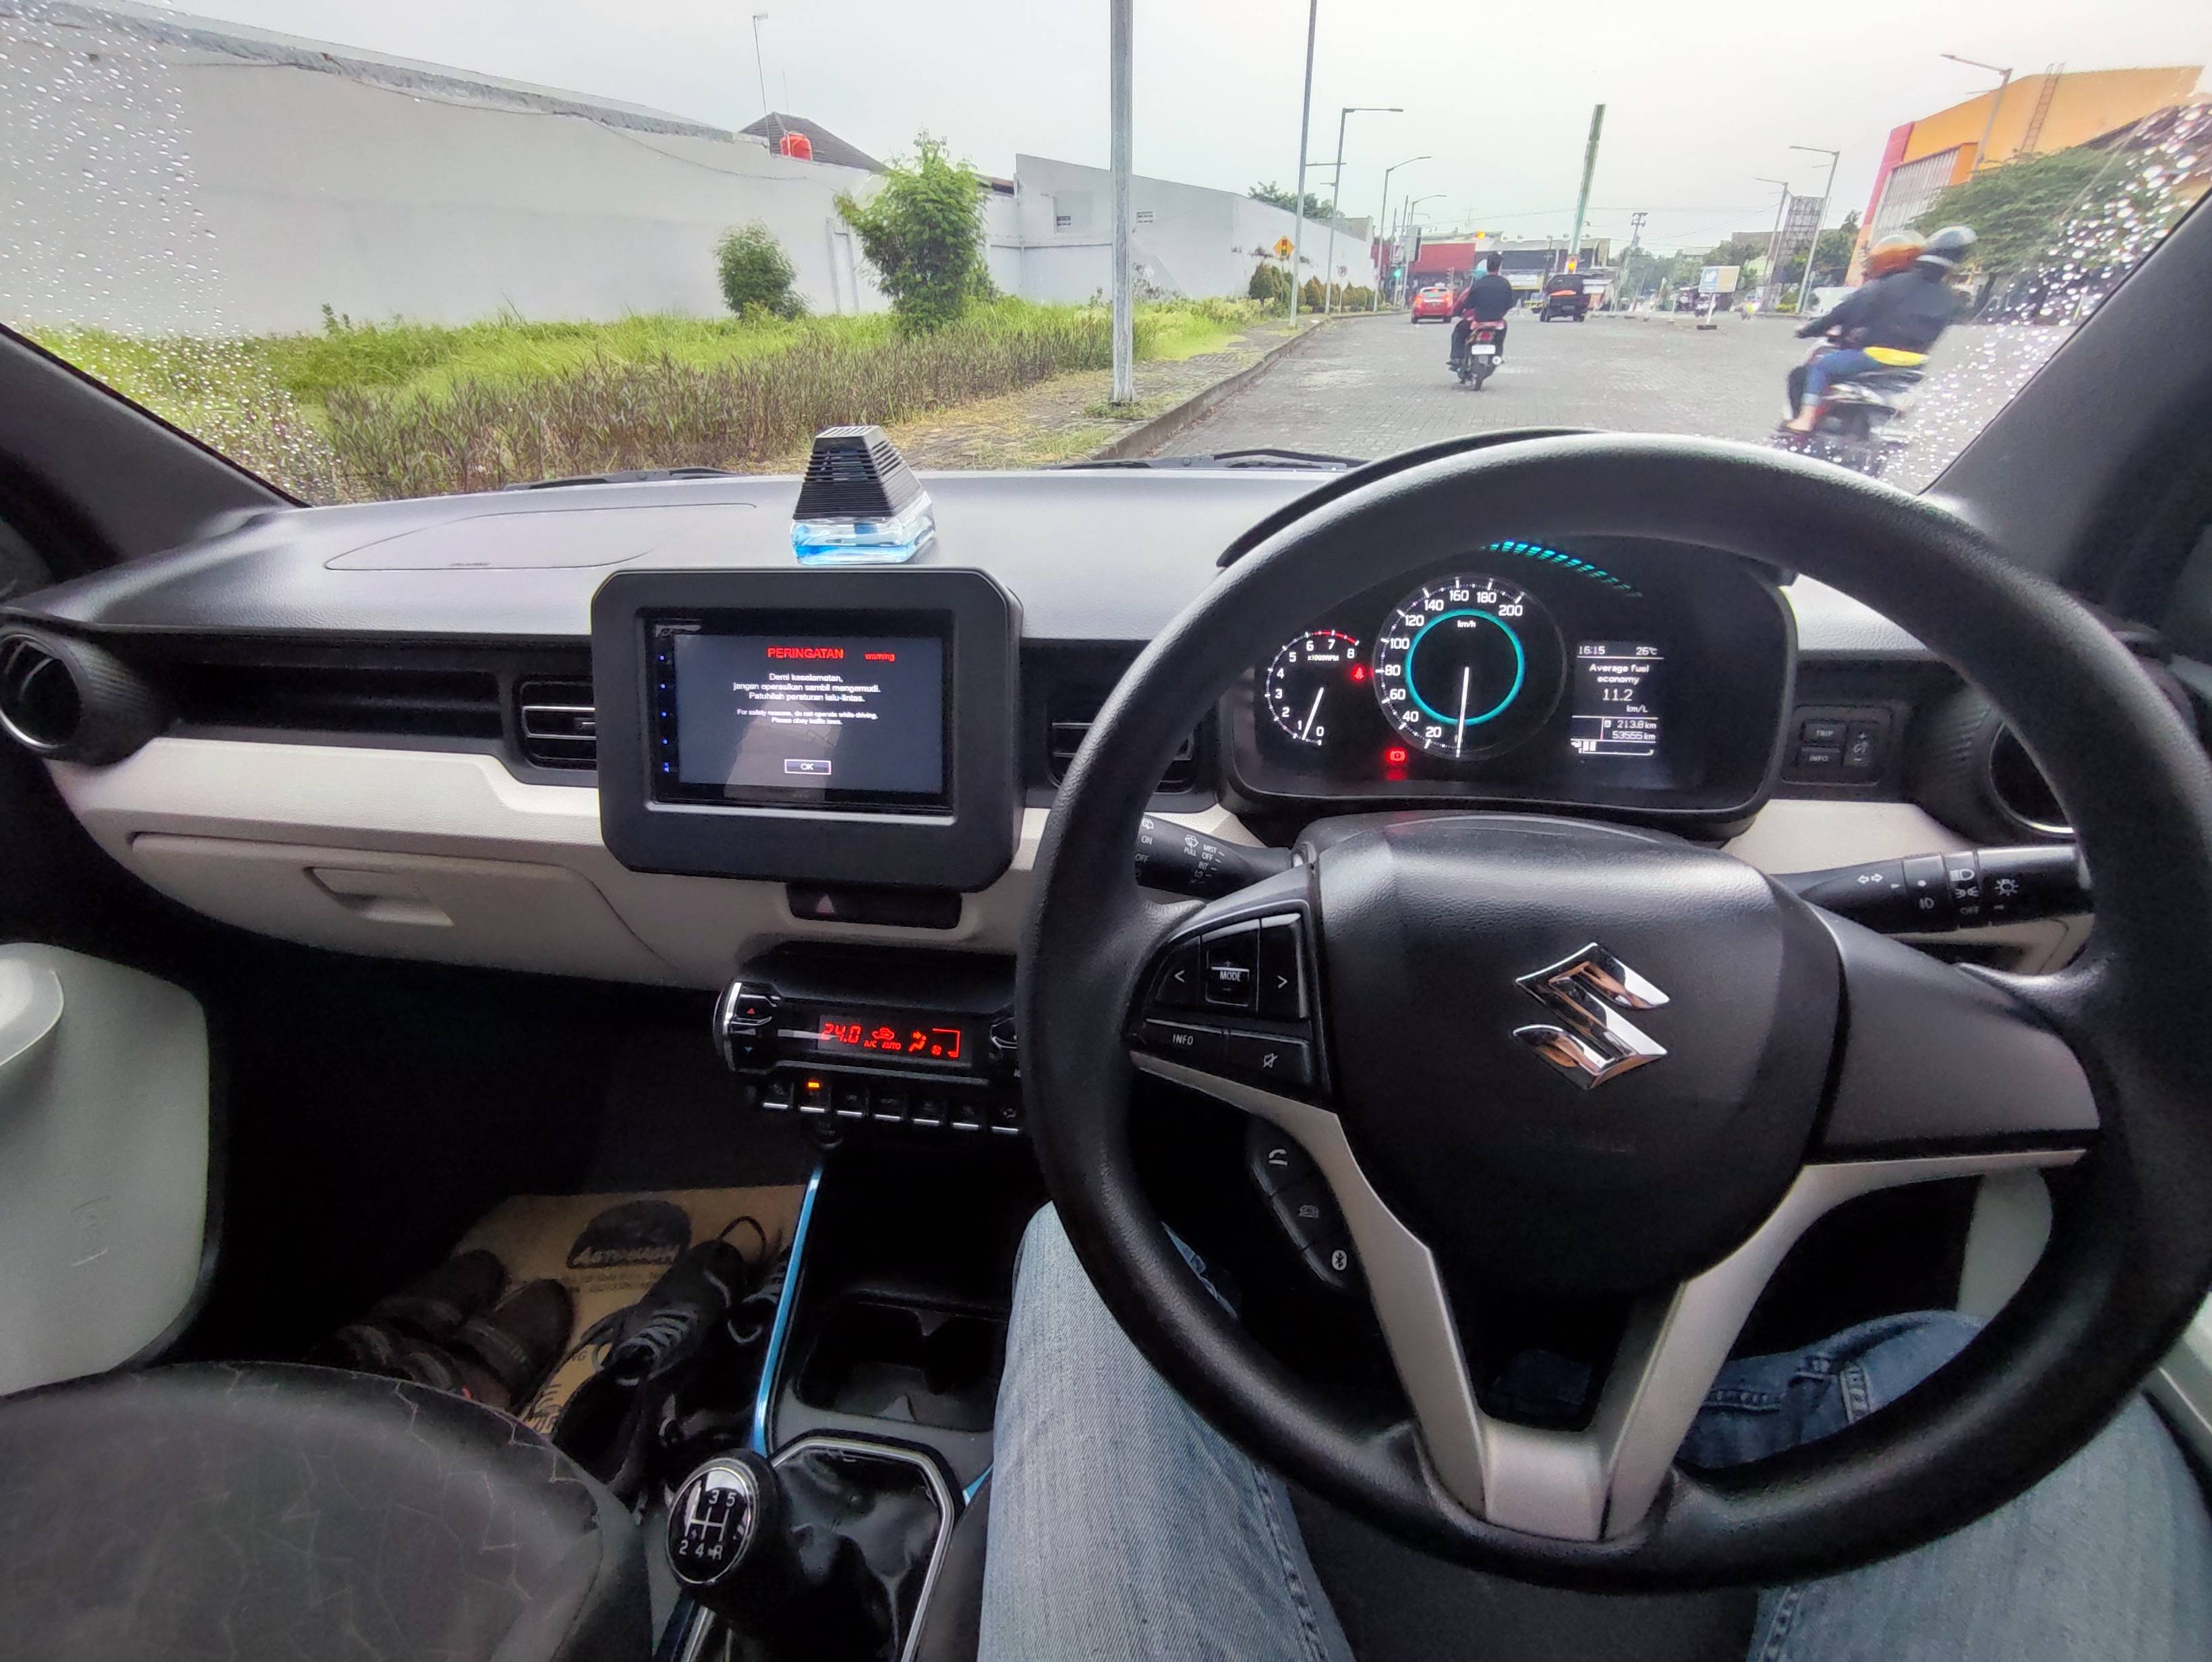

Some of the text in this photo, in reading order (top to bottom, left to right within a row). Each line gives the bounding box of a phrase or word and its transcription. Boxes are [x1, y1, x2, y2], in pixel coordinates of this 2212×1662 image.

[1450, 590, 1469, 602] 160
[1477, 592, 1496, 603] 180
[1424, 600, 1444, 611] 140
[1498, 604, 1523, 617] 200
[1405, 615, 1424, 626] 120
[1457, 620, 1476, 628] km/h
[1306, 641, 1314, 651] 6
[1328, 639, 1335, 650] 7
[1390, 638, 1409, 650] 100
[767, 648, 895, 661] PERINGATAN warning
[1347, 648, 1355, 659] 8
[1579, 646, 1606, 654] 16:15
[1289, 652, 1296, 662] 5
[1277, 668, 1284, 679] 4
[1385, 664, 1401, 676] 80
[1589, 664, 1650, 673] Average fuel
[791, 673, 843, 683] keselamatan,
[1597, 677, 1640, 685] economy
[733, 682, 759, 691] jangan
[805, 683, 830, 691] sambil
[786, 693, 823, 701] peraturan
[1275, 689, 1283, 699] 3
[1390, 689, 1405, 700] 60
[1602, 688, 1633, 701] 11.2
[1282, 706, 1289, 717] 2
[1627, 704, 1648, 713] km/L
[1403, 711, 1418, 722] 40
[1298, 720, 1302, 730] 1
[1617, 720, 1643, 728] 213.8
[1316, 726, 1324, 737] 0
[1426, 726, 1442, 738] 20
[1141, 836, 1153, 845] ON
[1184, 847, 1196, 857] PULL
[1203, 844, 1217, 854] MIST
[1134, 853, 1149, 863] OFF
[1202, 853, 1214, 861] OFF
[1198, 861, 1209, 871] INT
[1219, 971, 1242, 982] MODE
[821, 1023, 861, 1043] 24.0
[864, 1040, 902, 1050] A/C AUTO
[1172, 1034, 1194, 1045] INFO
[709, 1489, 720, 1504] 3
[726, 1492, 736, 1507] 5
[679, 1540, 723, 1560] 2 4 R
